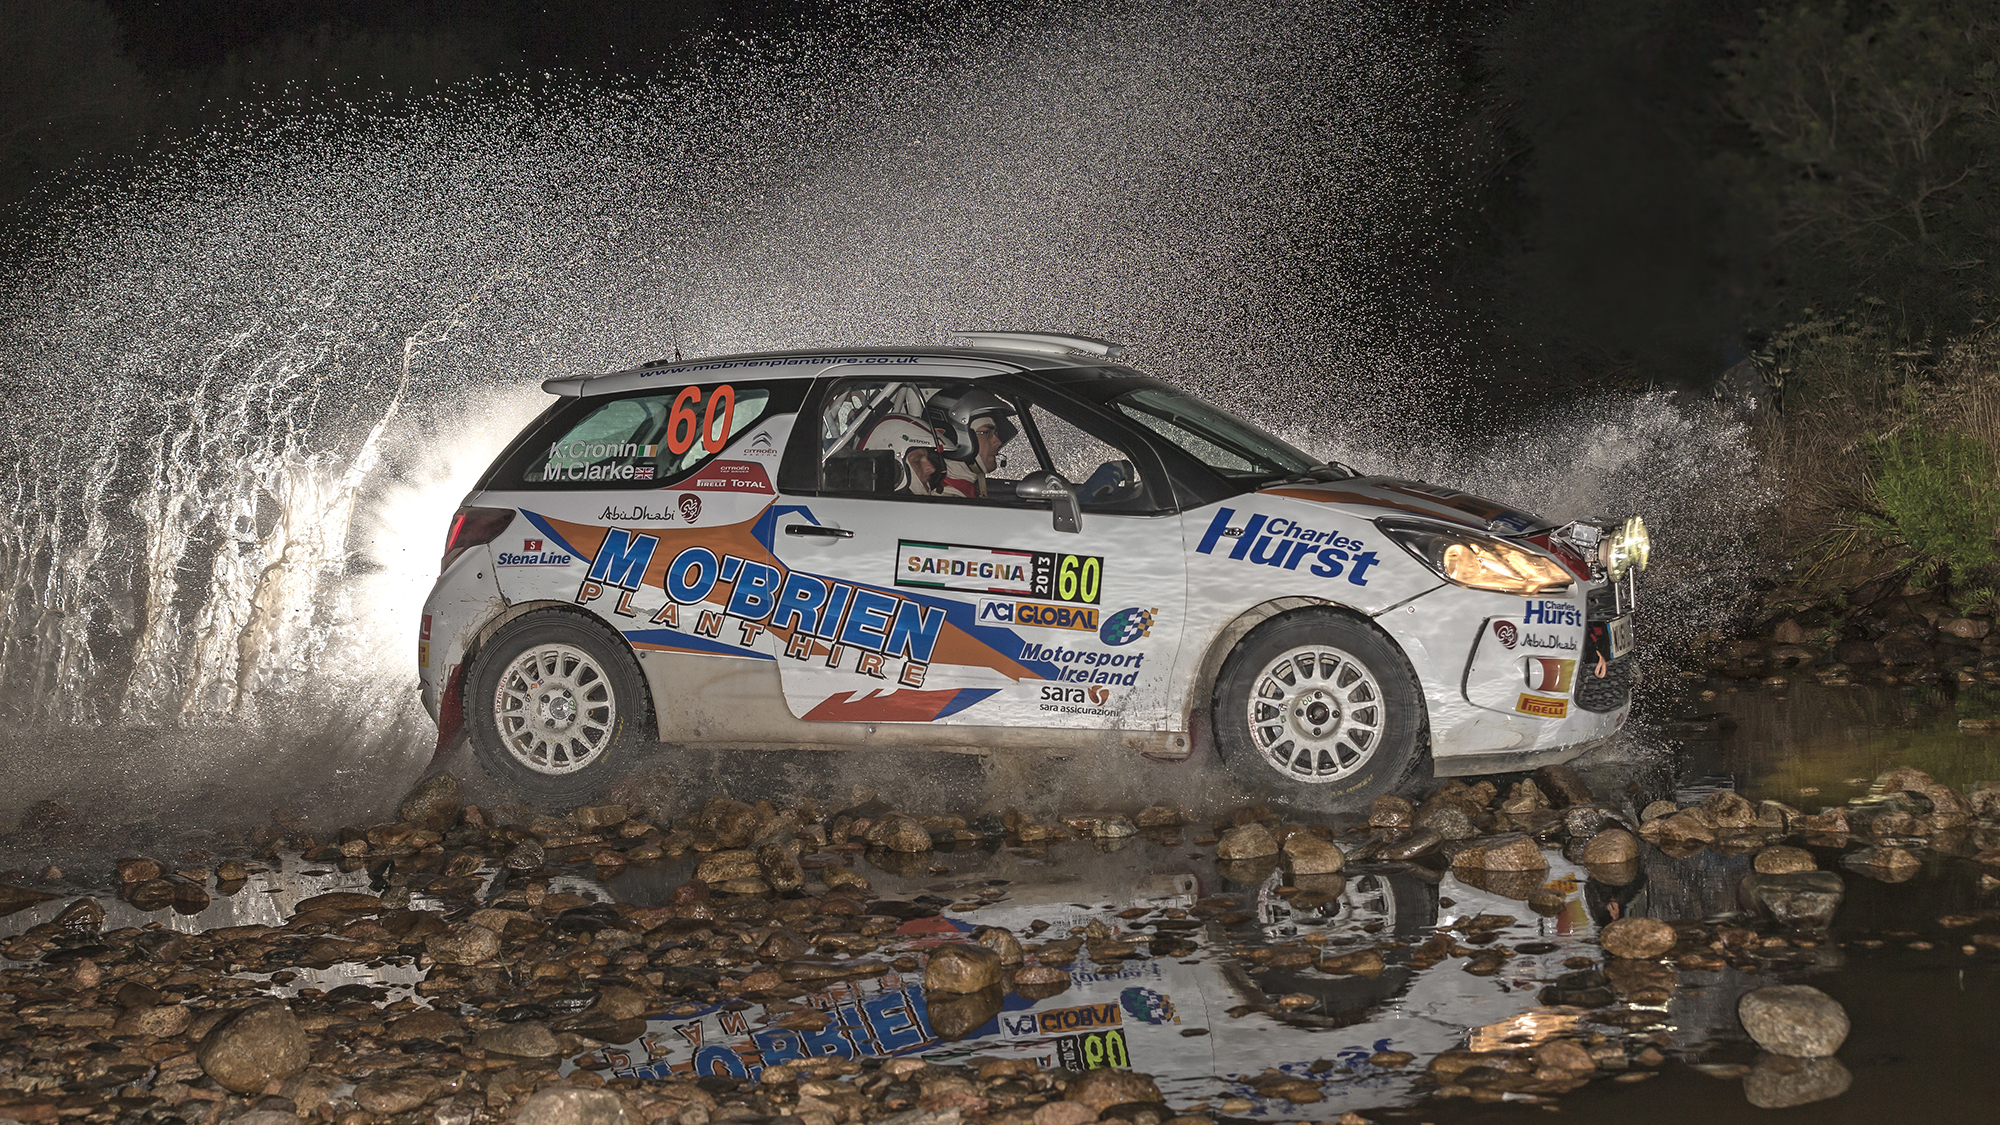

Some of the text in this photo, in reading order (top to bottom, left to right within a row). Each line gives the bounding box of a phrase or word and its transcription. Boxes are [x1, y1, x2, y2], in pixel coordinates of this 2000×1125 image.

[639, 356, 919, 378] www.mobrienplanthire.co.uk
[667, 384, 735, 455] 60
[548, 439, 637, 459] K.Cronin
[543, 461, 635, 481] M.Clarke
[696, 479, 766, 489] PIRELLI TOTAL
[1195, 507, 1380, 586] Hurst
[1266, 518, 1364, 551] Charles
[497, 552, 571, 565] Stena Line
[907, 556, 1025, 582] SARDEGNA
[1036, 556, 1051, 594] 2013
[1058, 554, 1100, 603] 60
[586, 526, 661, 590] M
[664, 547, 947, 663] O'BRIEN
[1545, 600, 1575, 611] Charles
[980, 602, 1097, 630] ACI GLOBAL
[1523, 600, 1582, 627] Hurst
[575, 580, 928, 688] PLANT HIRE
[1020, 643, 1144, 668] Motorsport
[1058, 665, 1139, 687] Ireland
[1040, 685, 1085, 703] sara
[1521, 698, 1564, 715] PIRELLI
[1039, 703, 1120, 717] sara assicurazioni
